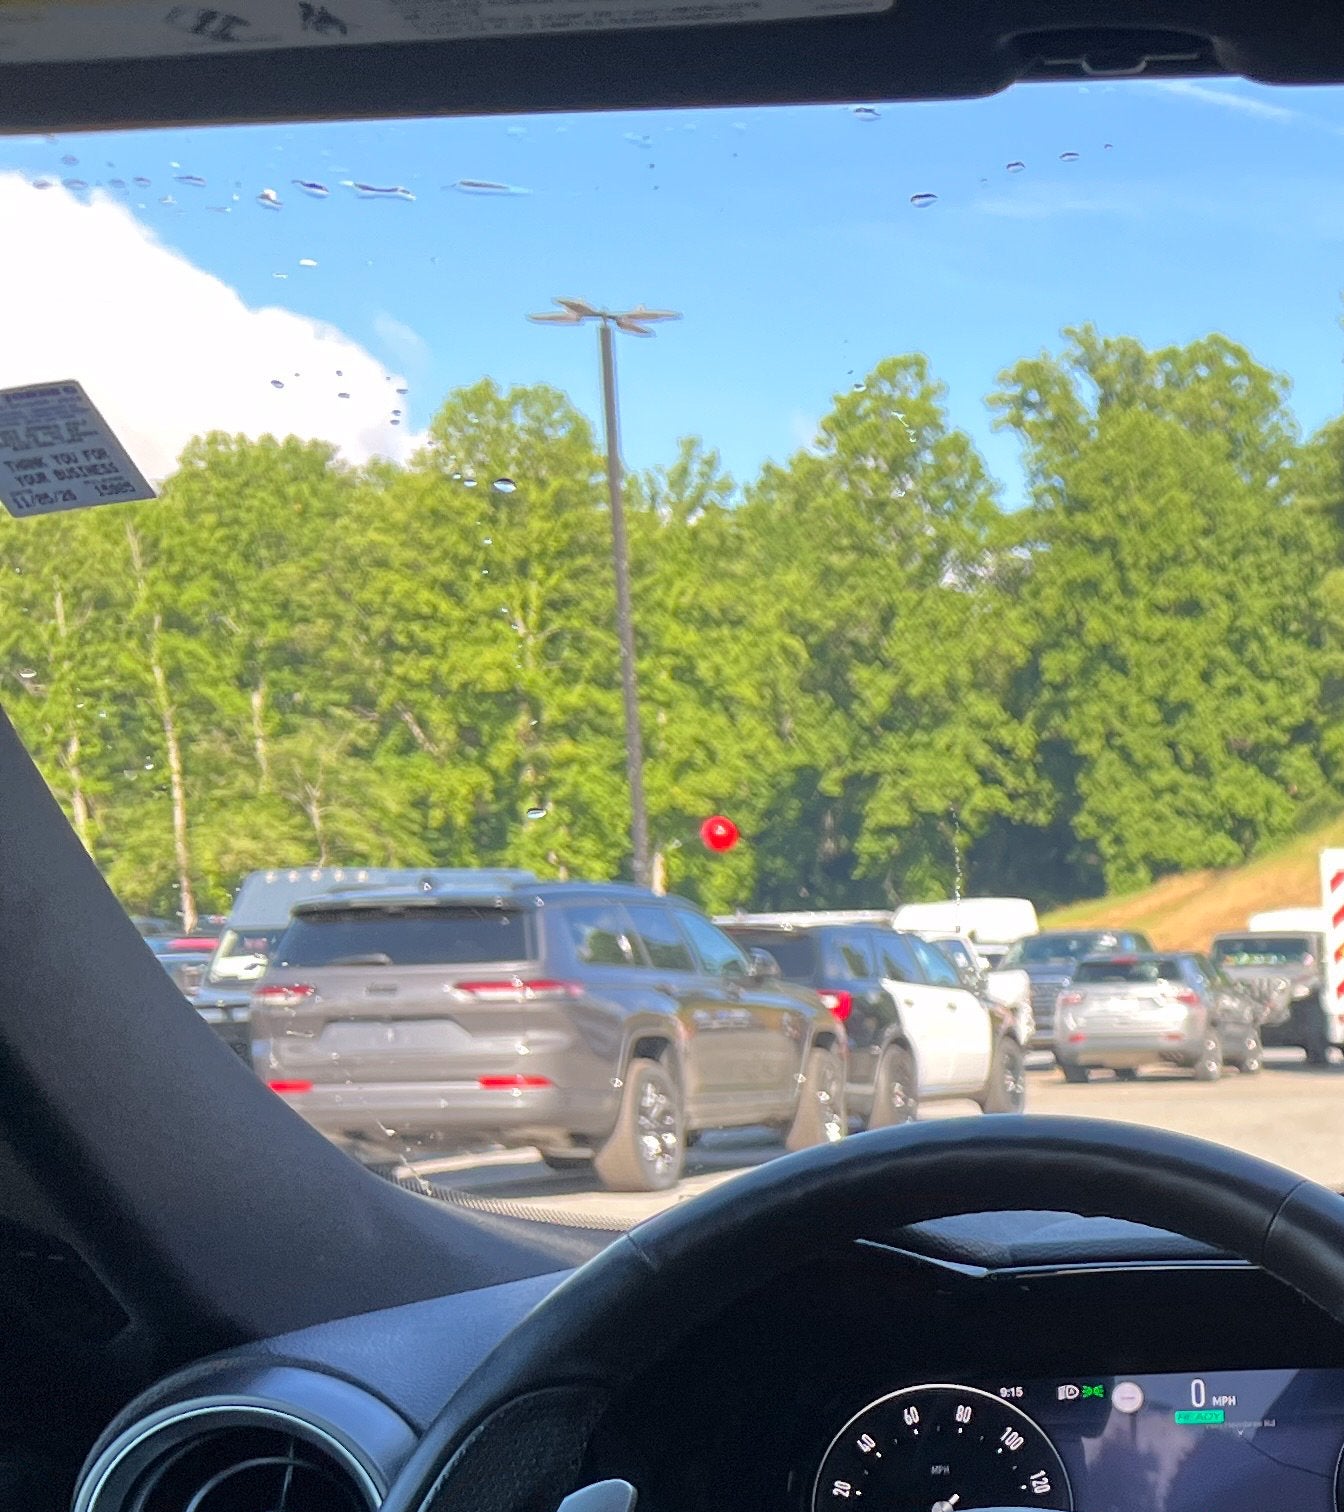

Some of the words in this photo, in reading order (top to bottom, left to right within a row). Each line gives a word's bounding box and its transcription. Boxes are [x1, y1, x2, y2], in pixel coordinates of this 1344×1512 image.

[3, 456, 48, 472] THANK
[50, 451, 79, 466] YOU
[81, 447, 109, 462] FOR
[15, 471, 50, 487] YOUR
[53, 461, 120, 481] BUSINESS
[1000, 1387, 1024, 1398] 9:15
[1191, 1378, 1206, 1408] 0
[1212, 1395, 1236, 1406] MPH
[903, 1406, 920, 1426] 60
[955, 1404, 972, 1424] 80
[856, 1433, 877, 1454] 40
[1000, 1426, 1025, 1451] 100
[832, 1480, 851, 1498] 20
[1029, 1470, 1051, 1494] 120
